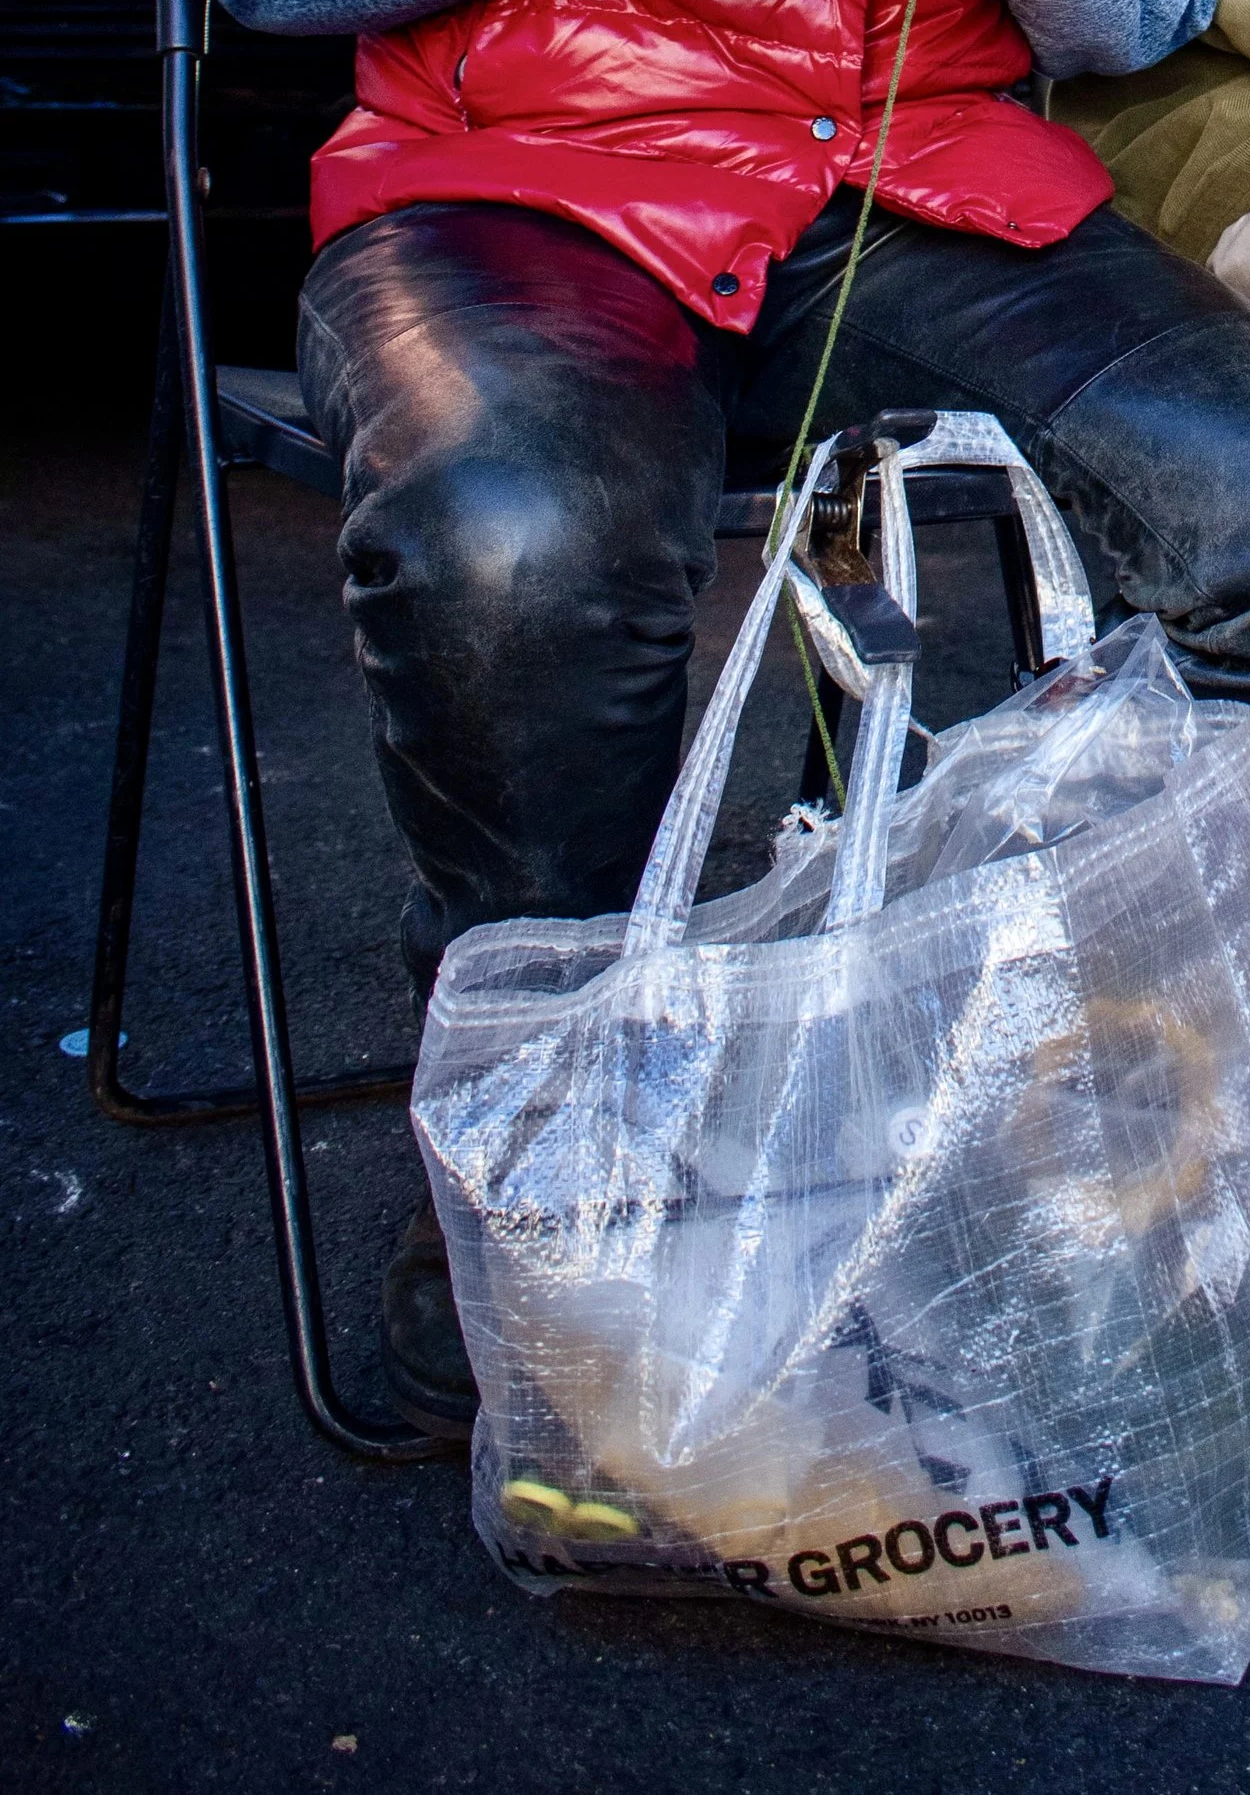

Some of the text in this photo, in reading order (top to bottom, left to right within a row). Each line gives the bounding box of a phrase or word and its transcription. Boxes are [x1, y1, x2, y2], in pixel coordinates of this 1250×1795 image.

[788, 1476, 1114, 1597] GROCERY
[911, 1615, 940, 1627] NY
[945, 1604, 1012, 1625] 10013
